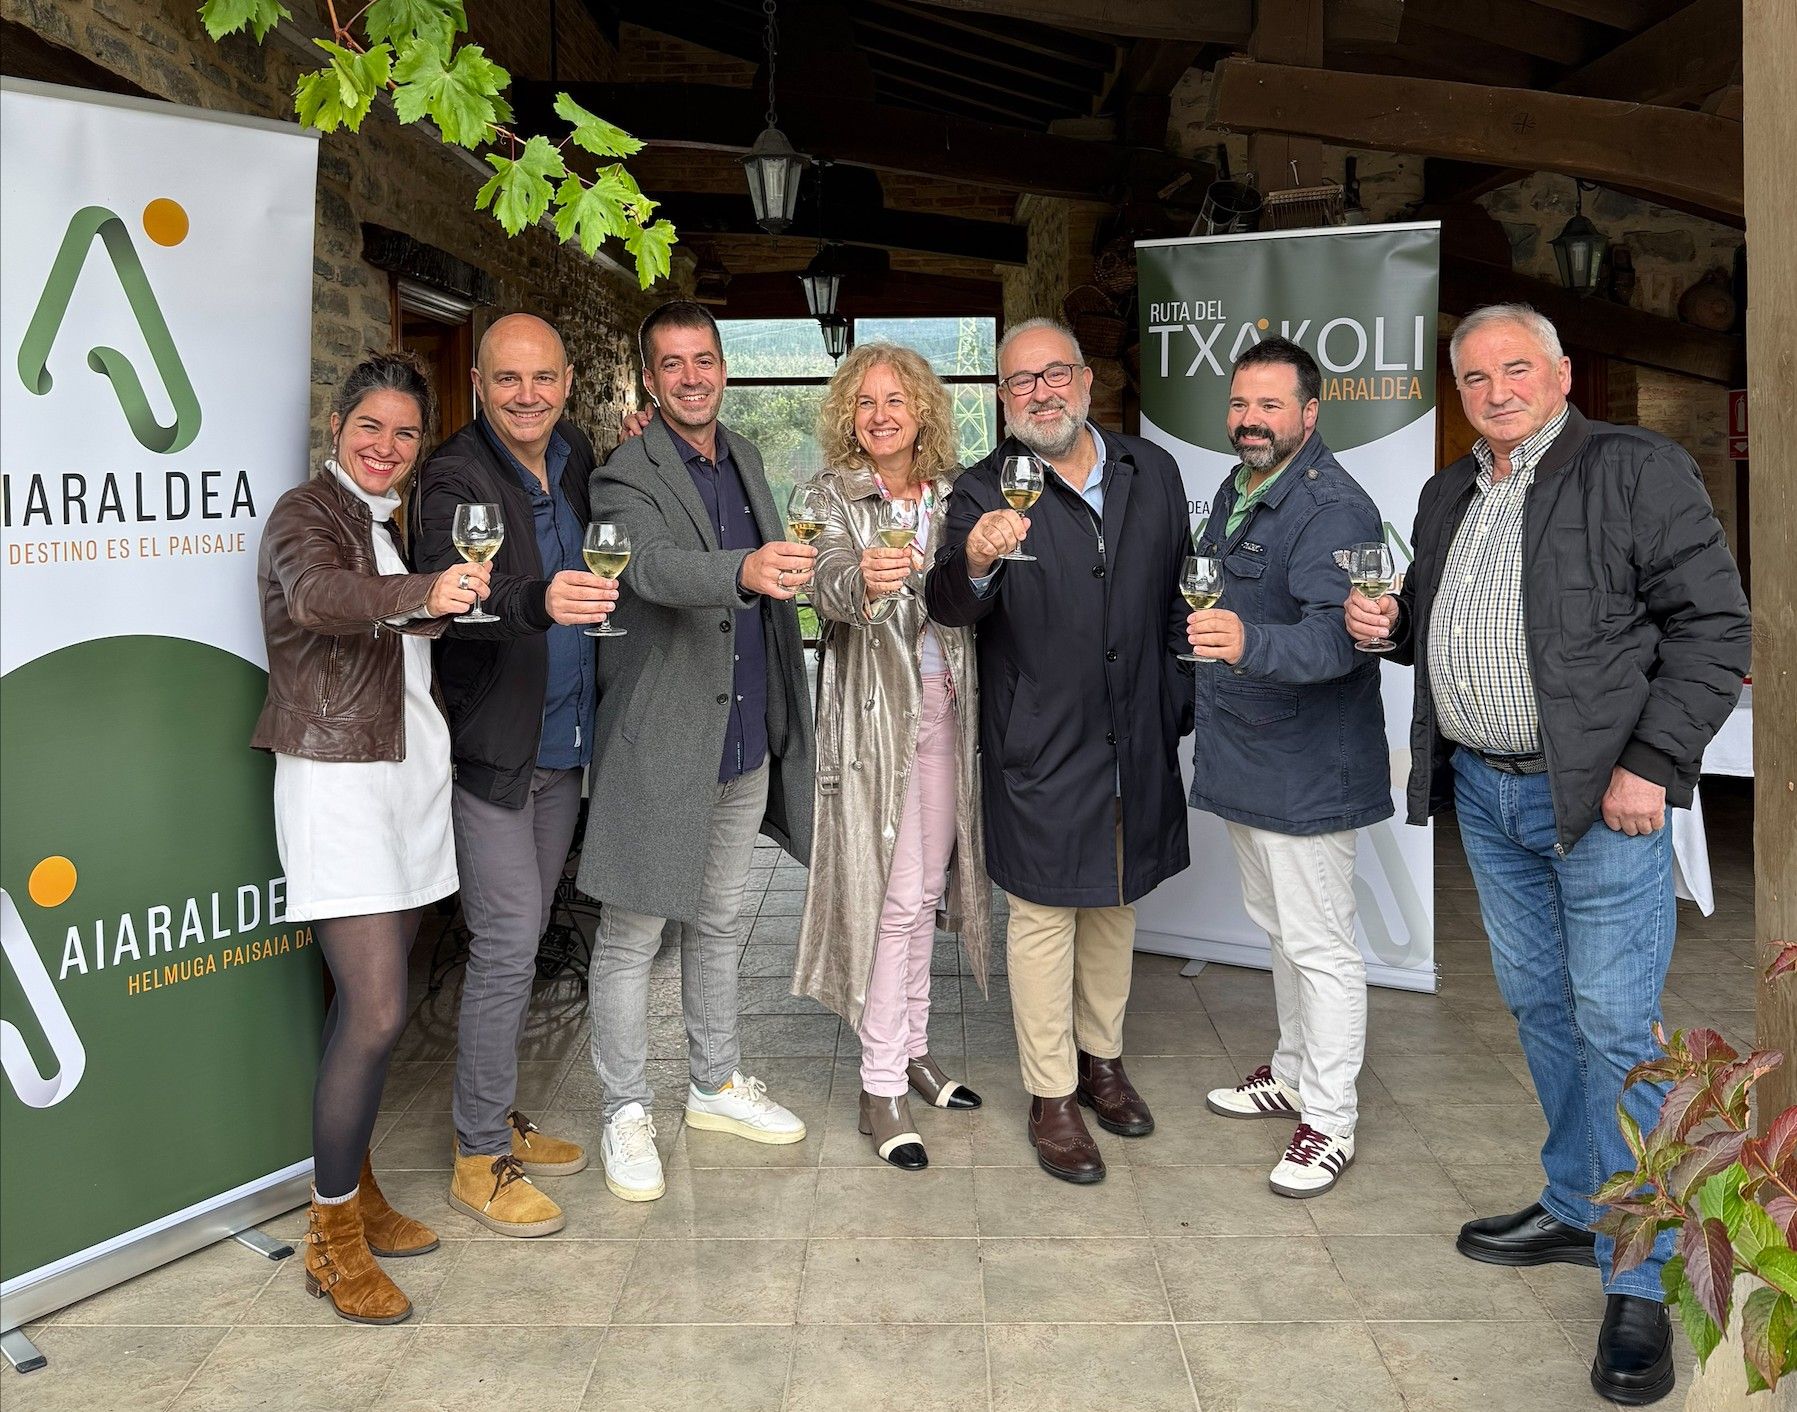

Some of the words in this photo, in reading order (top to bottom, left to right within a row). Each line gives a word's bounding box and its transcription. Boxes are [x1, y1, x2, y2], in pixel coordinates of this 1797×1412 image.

[1150, 301, 1191, 322] RUTA
[1195, 300, 1226, 320] DEL
[1319, 376, 1422, 401] IARALDEA
[9, 539, 98, 565] DESTINO
[107, 538, 130, 559] ES
[140, 536, 160, 557] EL
[170, 532, 246, 555] PAISAJE
[128, 953, 217, 996] HELMUGA
[223, 934, 290, 970] PAISAIA
[295, 926, 313, 949] DA
